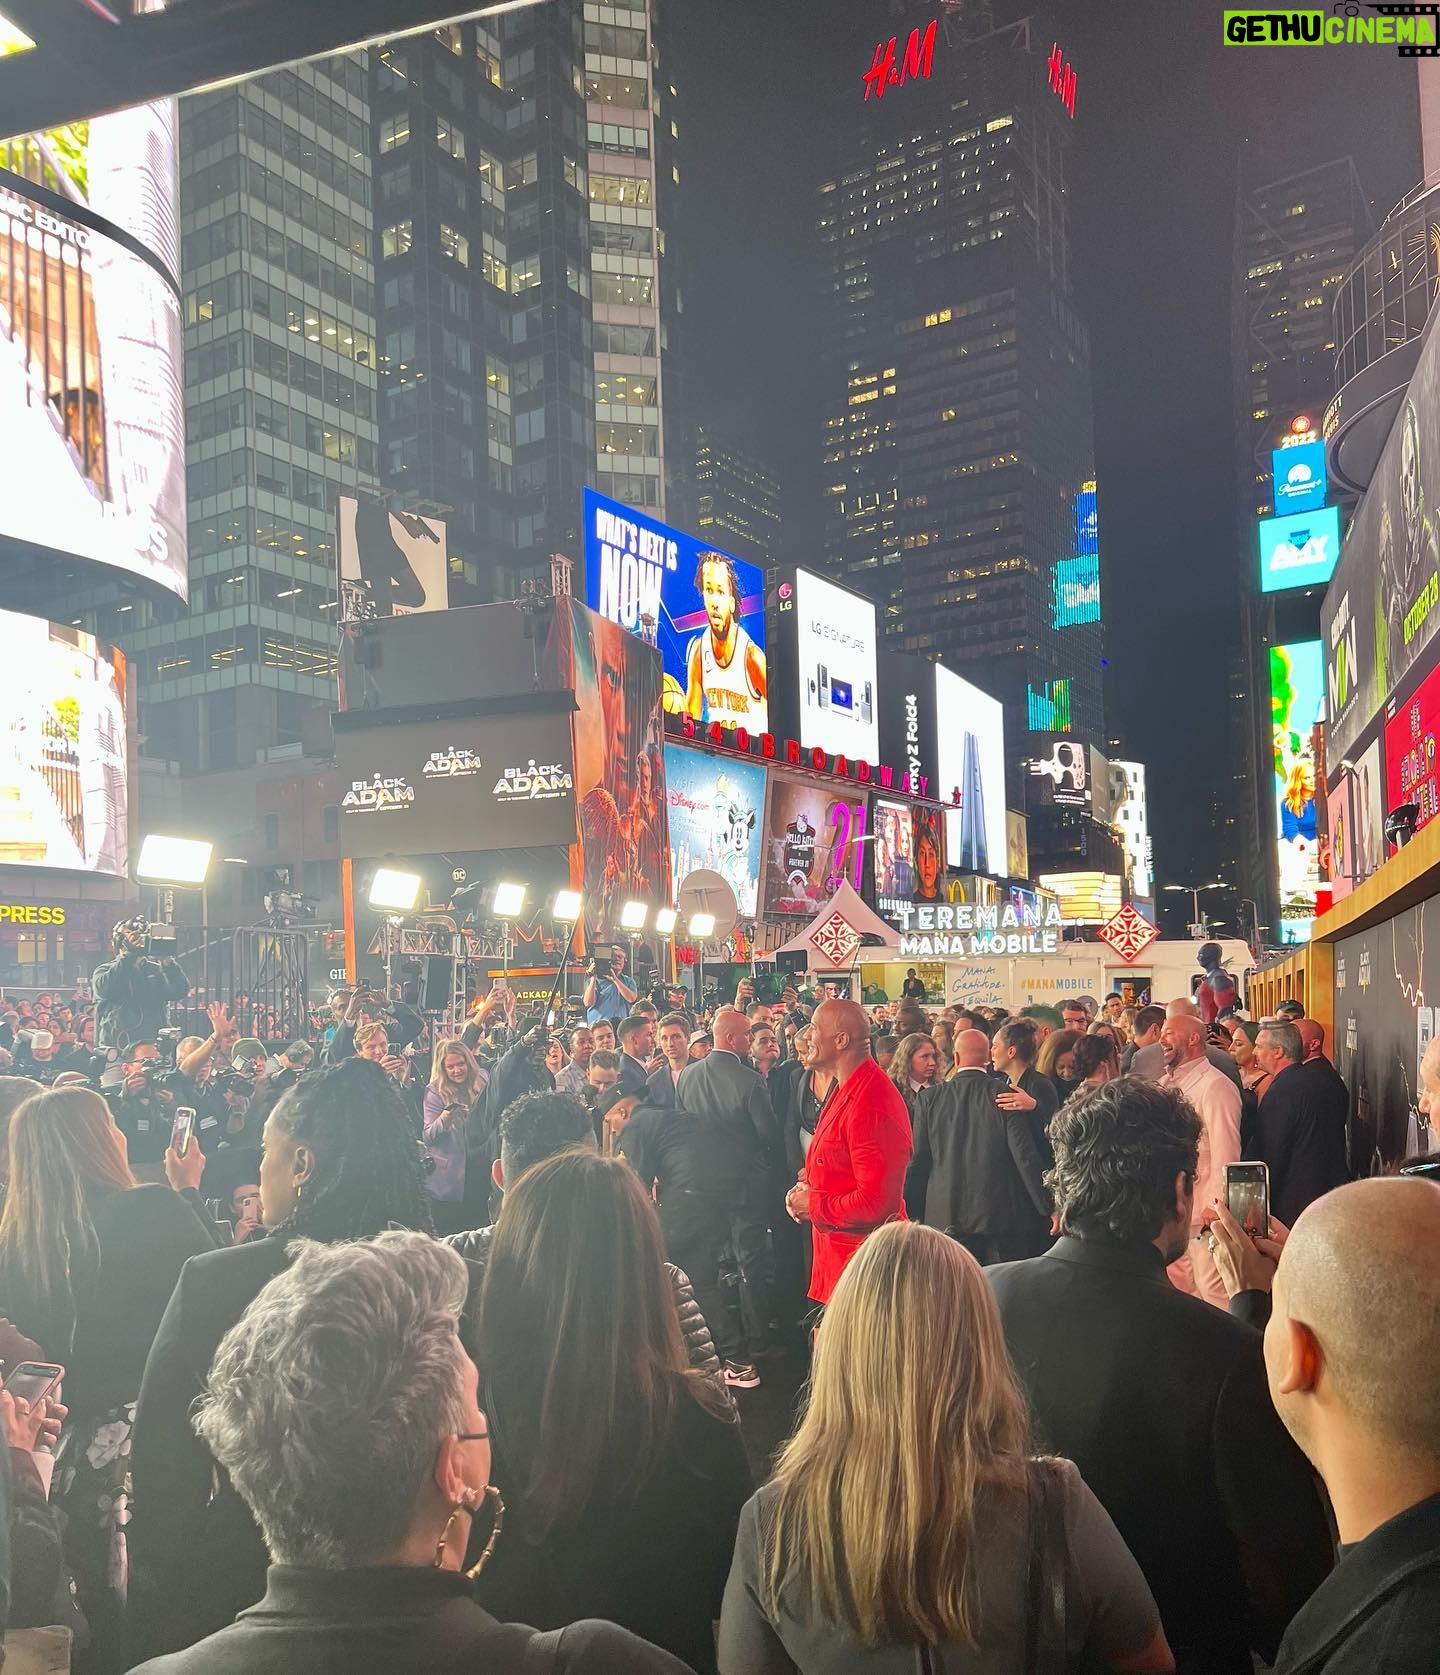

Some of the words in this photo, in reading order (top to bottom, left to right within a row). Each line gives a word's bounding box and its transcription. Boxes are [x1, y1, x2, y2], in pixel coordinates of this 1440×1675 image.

[862, 20, 938, 102] H&M
[1048, 42, 1077, 119] H&M
[1281, 431, 1317, 449] 2022
[596, 507, 638, 554] WHAT'S
[639, 527, 665, 566] NEXT
[666, 539, 678, 571] IS
[599, 543, 662, 648] NOW
[779, 600, 792, 612] LG
[905, 693, 919, 742] Fold4
[422, 756, 482, 776] ADAM
[431, 748, 475, 760] BLACK
[761, 732, 928, 797] BROADWAY
[352, 775, 407, 791] BLACK
[504, 762, 564, 779] BLACK
[341, 786, 415, 811] ADAM
[492, 773, 573, 799] ADAM
[830, 801, 867, 892] 21
[0, 905, 65, 925] PRESS
[897, 903, 1063, 930] TEREMANA
[900, 935, 965, 956] MANA
[970, 934, 1057, 956] MOBILE
[1022, 978, 1093, 990] #MANAMOBILE
